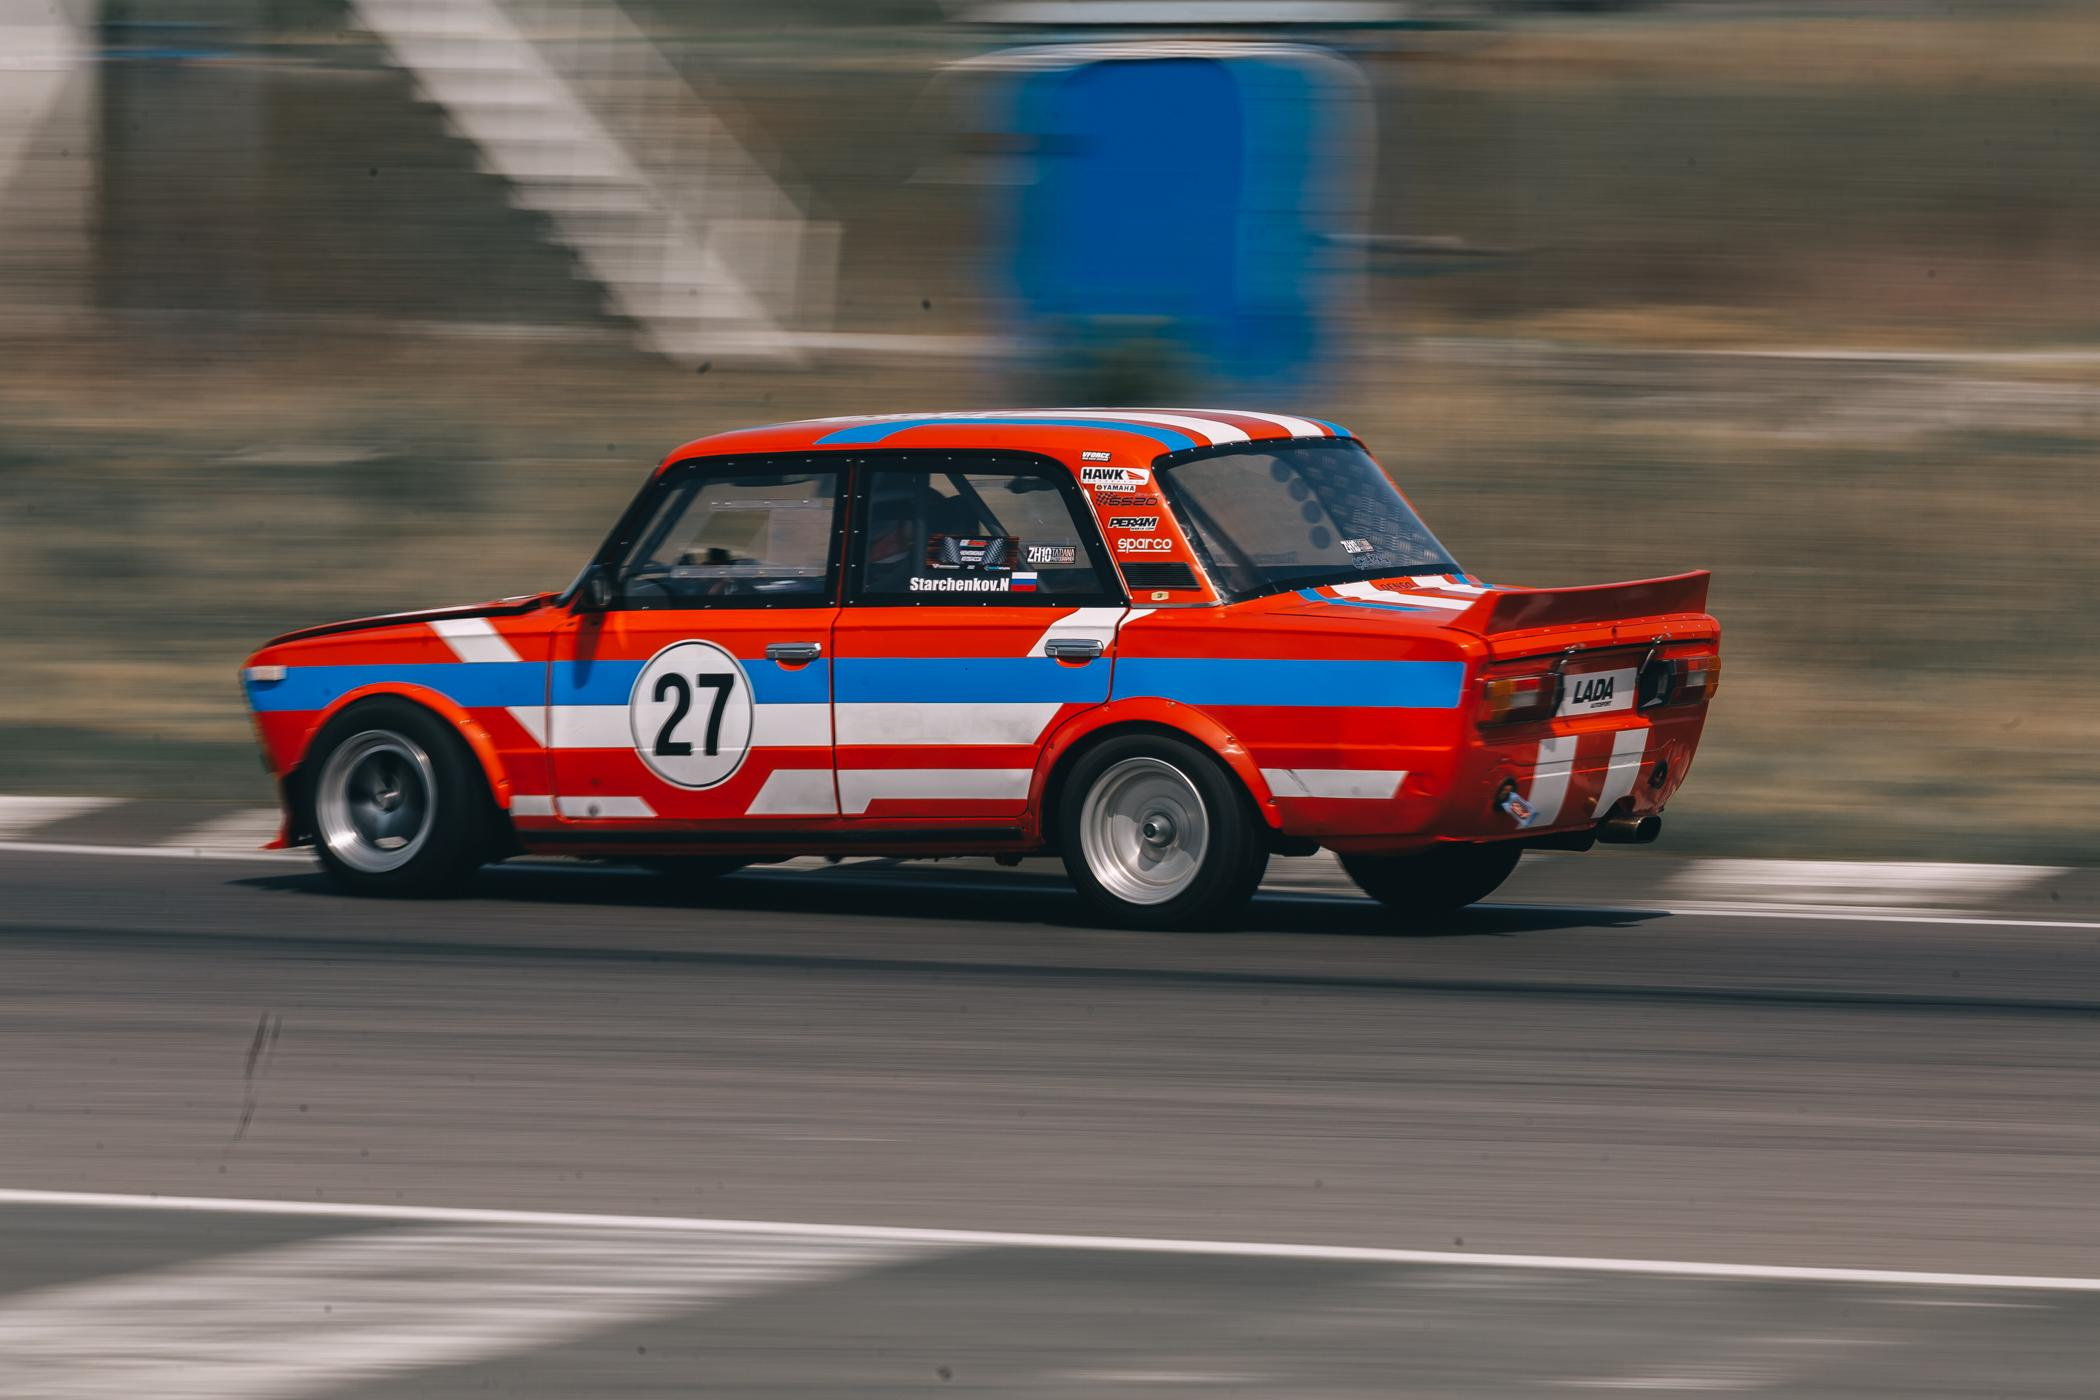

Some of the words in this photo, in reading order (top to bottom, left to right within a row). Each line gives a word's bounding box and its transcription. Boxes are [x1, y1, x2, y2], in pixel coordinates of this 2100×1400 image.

[1082, 468, 1125, 480] HAWK
[1103, 484, 1135, 492] YAMAHA
[1117, 537, 1172, 553] sparco
[909, 577, 1010, 592] Starchenkov.N
[1571, 676, 1615, 704] LADA
[652, 672, 735, 756] 27
